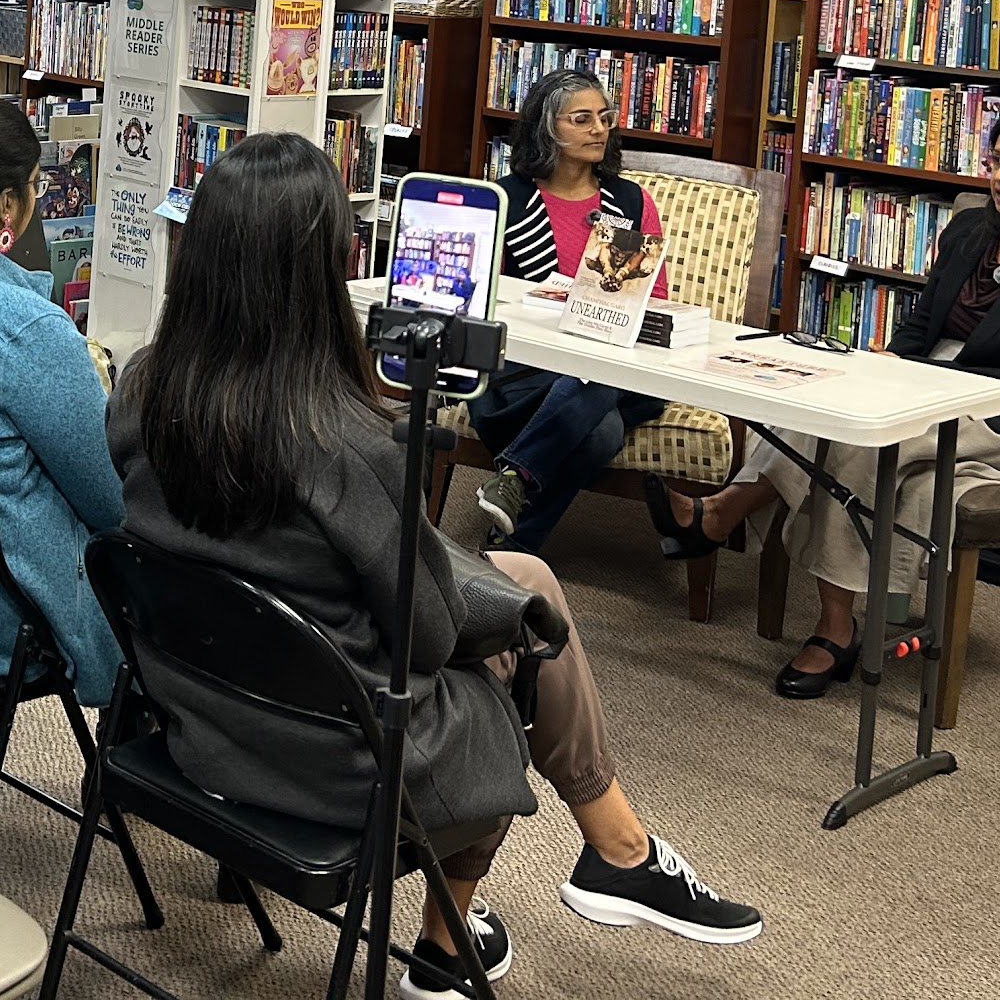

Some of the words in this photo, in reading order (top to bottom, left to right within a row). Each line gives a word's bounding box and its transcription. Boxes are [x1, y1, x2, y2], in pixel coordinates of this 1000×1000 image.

[274, 6, 300, 25] WOULD
[301, 7, 321, 26] WIN?
[126, 16, 164, 32] MIDDLE
[125, 29, 163, 44] READER
[127, 42, 159, 57] SERIES
[119, 90, 155, 105] SPOOKY
[121, 190, 147, 205] ONLY
[137, 206, 149, 214] YOU
[111, 212, 122, 220] CAN
[132, 217, 149, 226] EASILY
[118, 223, 126, 235] BE
[116, 234, 127, 243] AND
[111, 242, 130, 252] HARDLY
[118, 252, 147, 269] EFFORT
[570, 299, 630, 328] UNEARTHED
